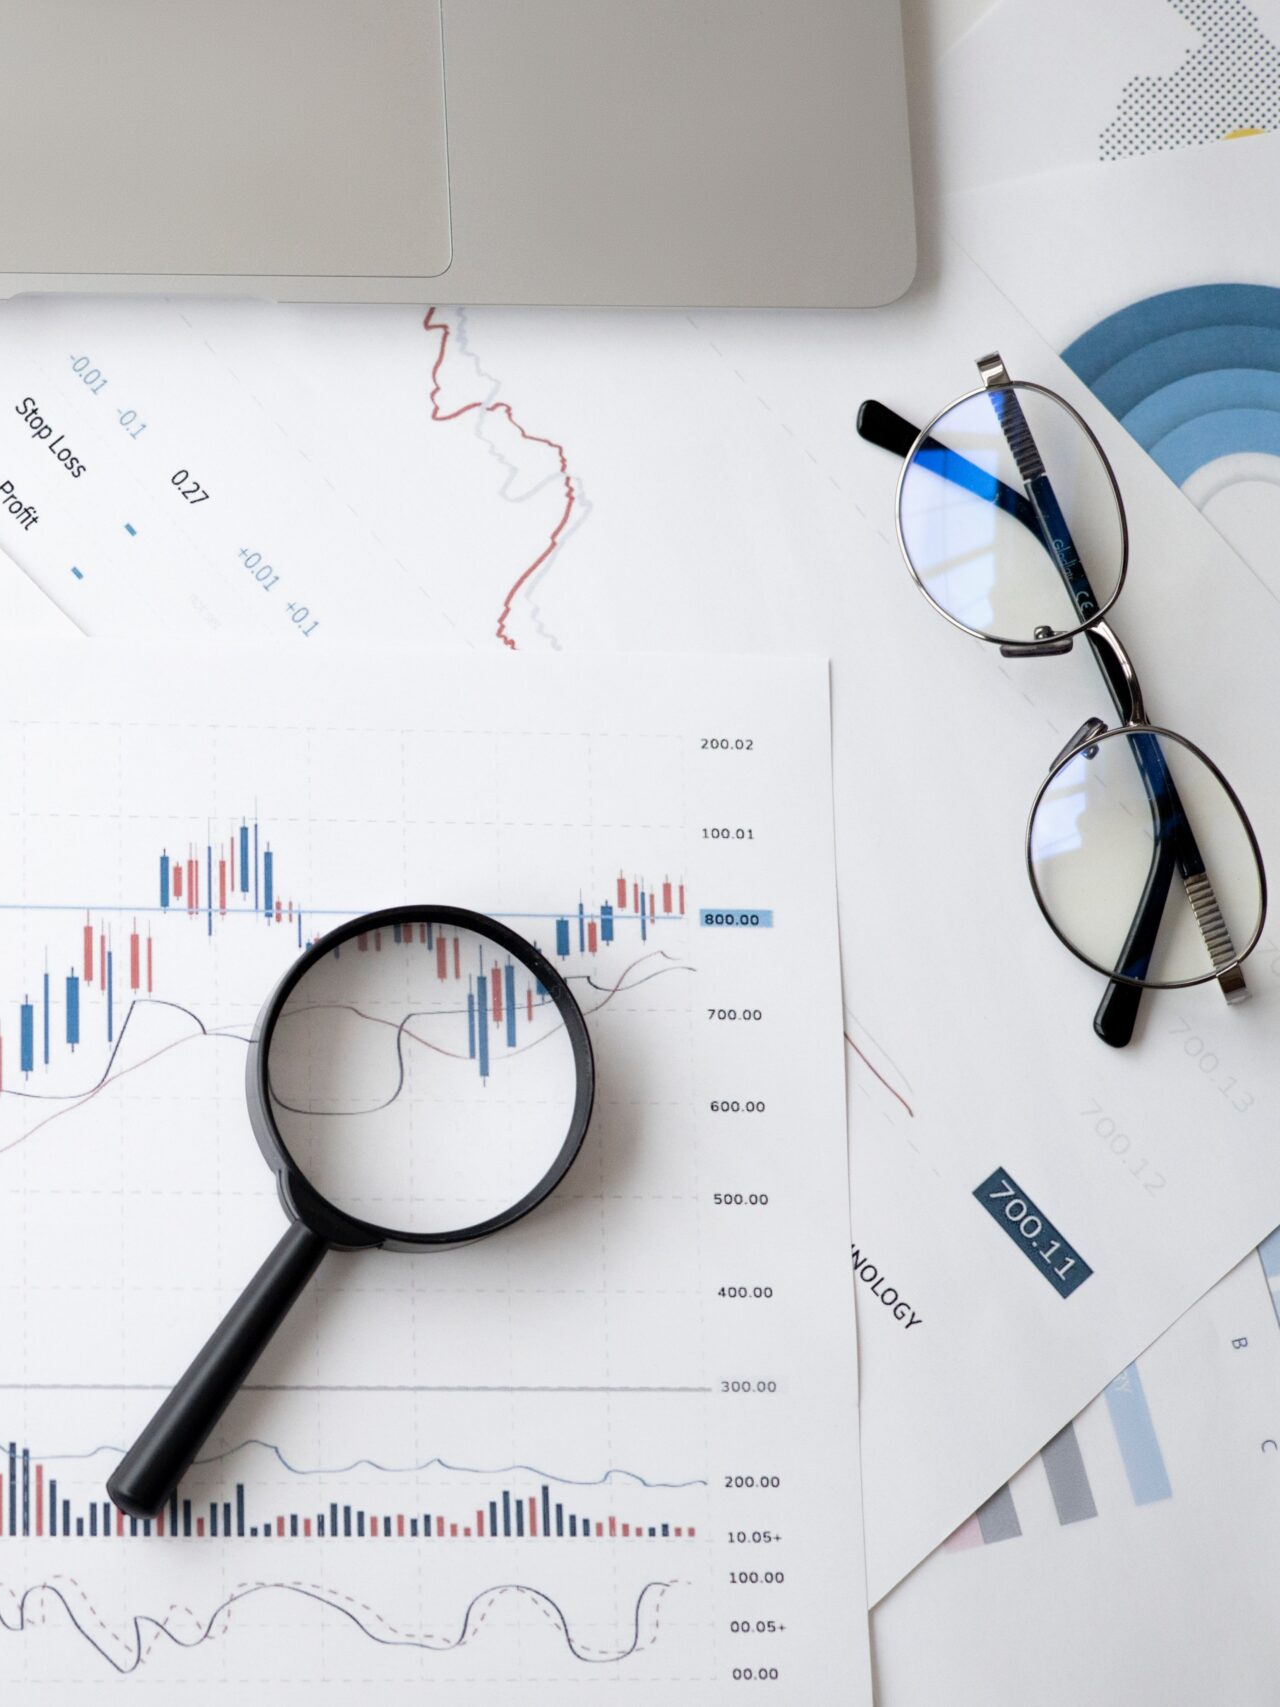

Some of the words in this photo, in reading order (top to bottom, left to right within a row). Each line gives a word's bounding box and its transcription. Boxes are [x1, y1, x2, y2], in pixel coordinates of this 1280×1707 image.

[15, 397, 53, 440] Stop
[48, 435, 87, 478] Loss
[70, 356, 108, 395] -0.01
[117, 409, 147, 440] -0.1
[171, 469, 210, 505] 0.27
[238, 548, 280, 592] +0.01
[286, 602, 319, 637] +0.1
[701, 738, 754, 751] 200.02
[702, 828, 754, 840] 100.01
[705, 914, 759, 925] 800.00
[707, 1009, 762, 1021] 700.00
[1169, 1016, 1255, 1113] 700.13
[710, 1101, 765, 1113] 600.00
[1080, 1098, 1167, 1197] 700.12
[714, 1193, 768, 1205] 500.00
[989, 1179, 1076, 1281] 700.11
[718, 1287, 773, 1299] 400.00
[1232, 1337, 1248, 1350] B
[721, 1381, 776, 1392] 300.00
[1261, 1439, 1278, 1453] C
[725, 1476, 780, 1488] 200.00
[730, 1572, 784, 1584] 100.00
[732, 1668, 778, 1680] 00.00
